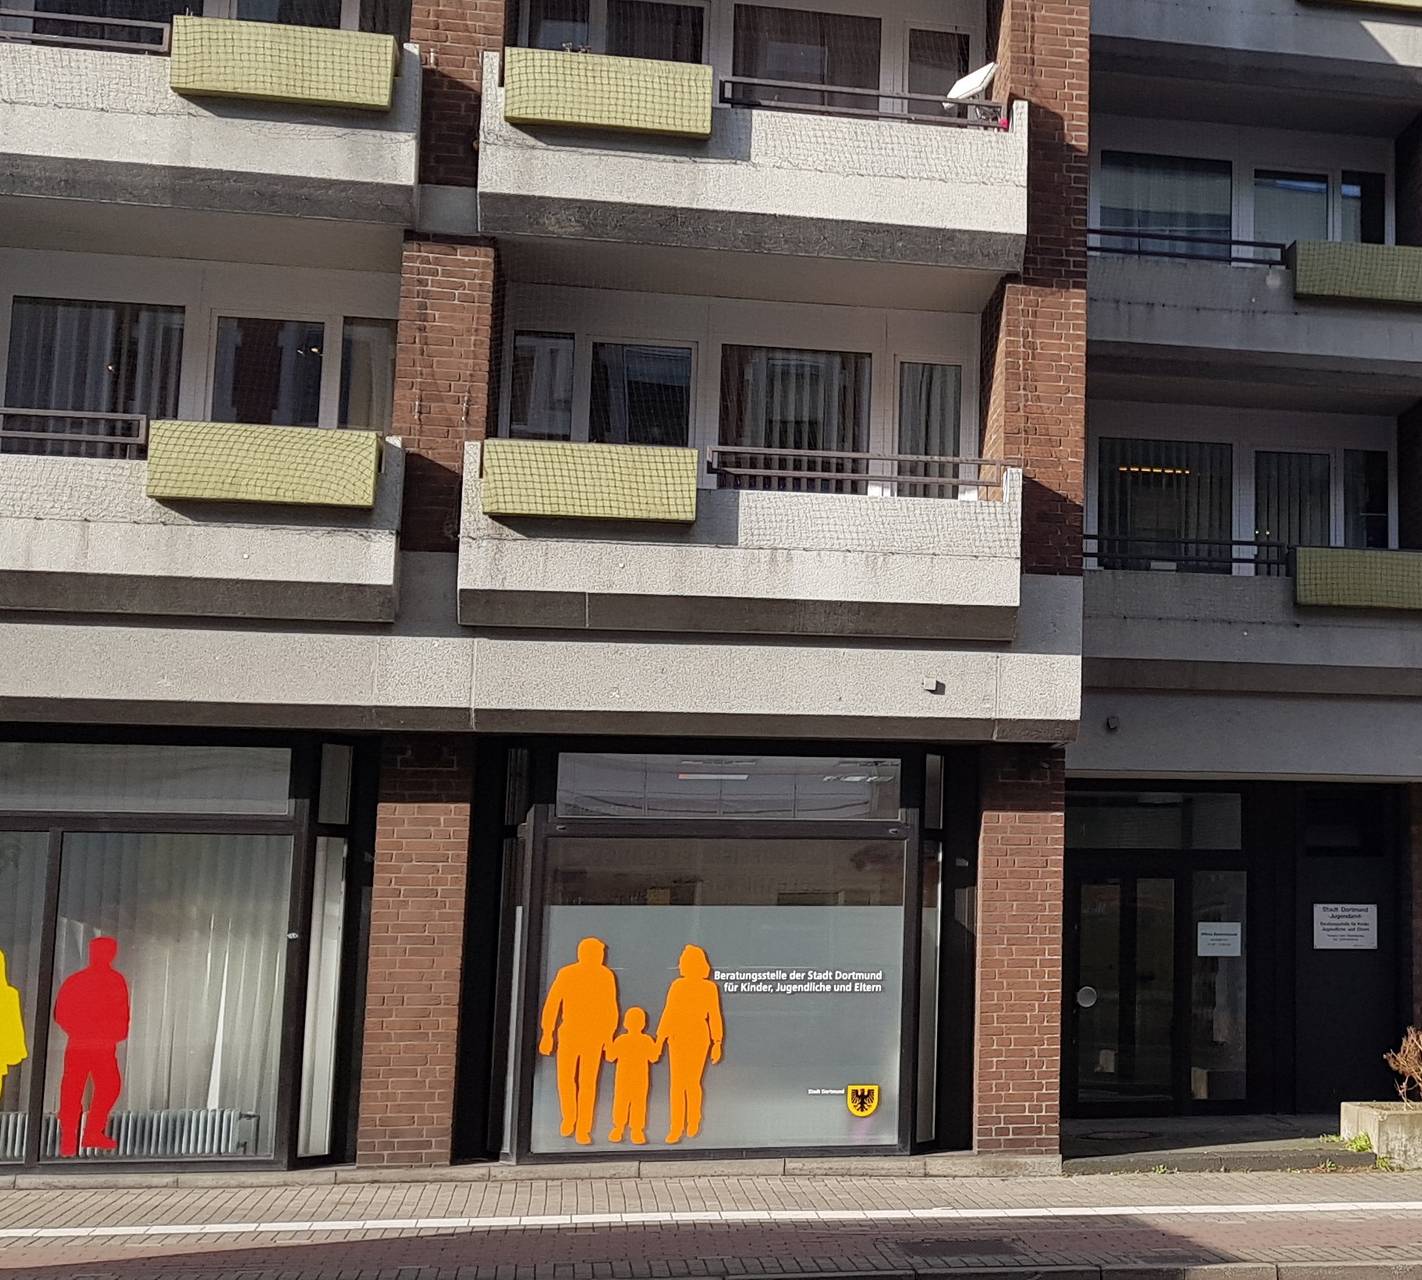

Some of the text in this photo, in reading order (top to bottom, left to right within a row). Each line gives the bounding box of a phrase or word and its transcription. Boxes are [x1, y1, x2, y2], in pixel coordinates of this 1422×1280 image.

[714, 970, 882, 982] Beratungsstelle der Stadt Dortmund
[723, 982, 882, 994] für Kinder, Jugendliche und Eltern
